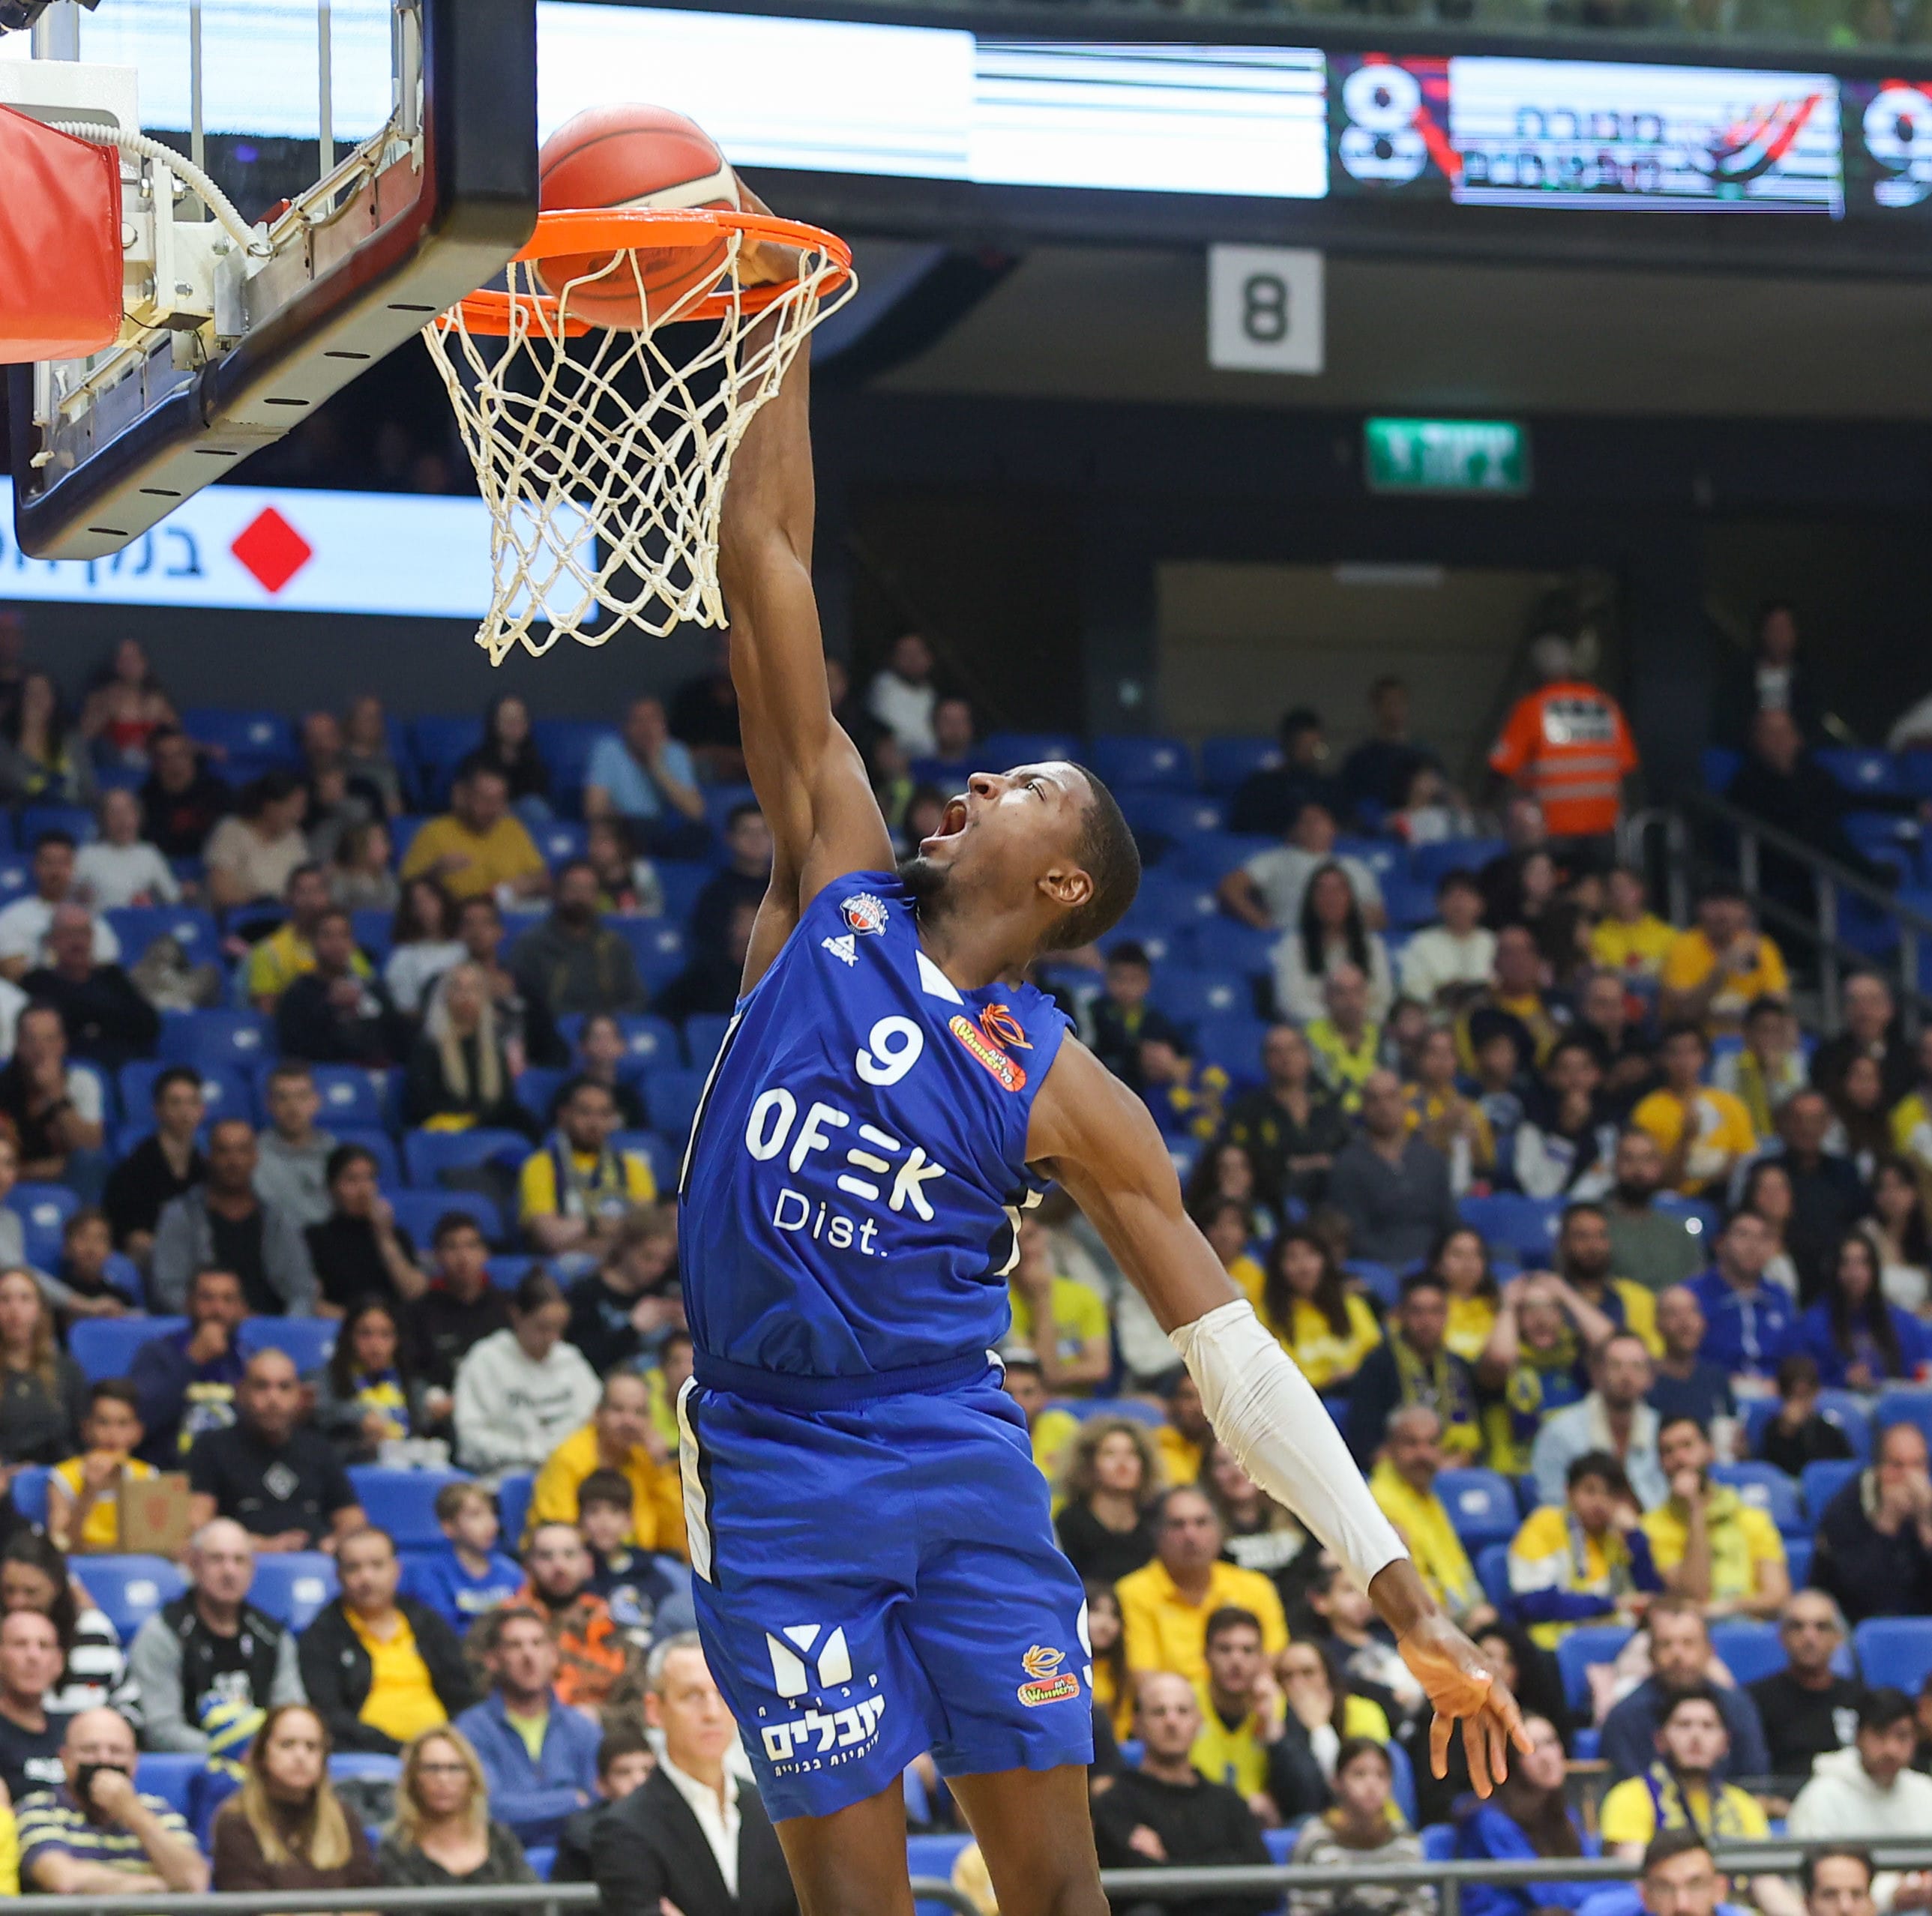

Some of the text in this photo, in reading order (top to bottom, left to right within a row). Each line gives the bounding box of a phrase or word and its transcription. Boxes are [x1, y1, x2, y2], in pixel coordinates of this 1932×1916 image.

[1339, 64, 1428, 184] 8
[1863, 87, 1932, 208] 9
[1242, 273, 1289, 343] 8
[821, 936, 859, 968] PEAK
[855, 1015, 924, 1086] 9
[957, 1023, 1002, 1070] Winner
[745, 1088, 946, 1221] OFEK
[773, 1189, 888, 1257] Dist.
[761, 1694, 885, 1762] יובלים
[1026, 1687, 1068, 1702] Winner
